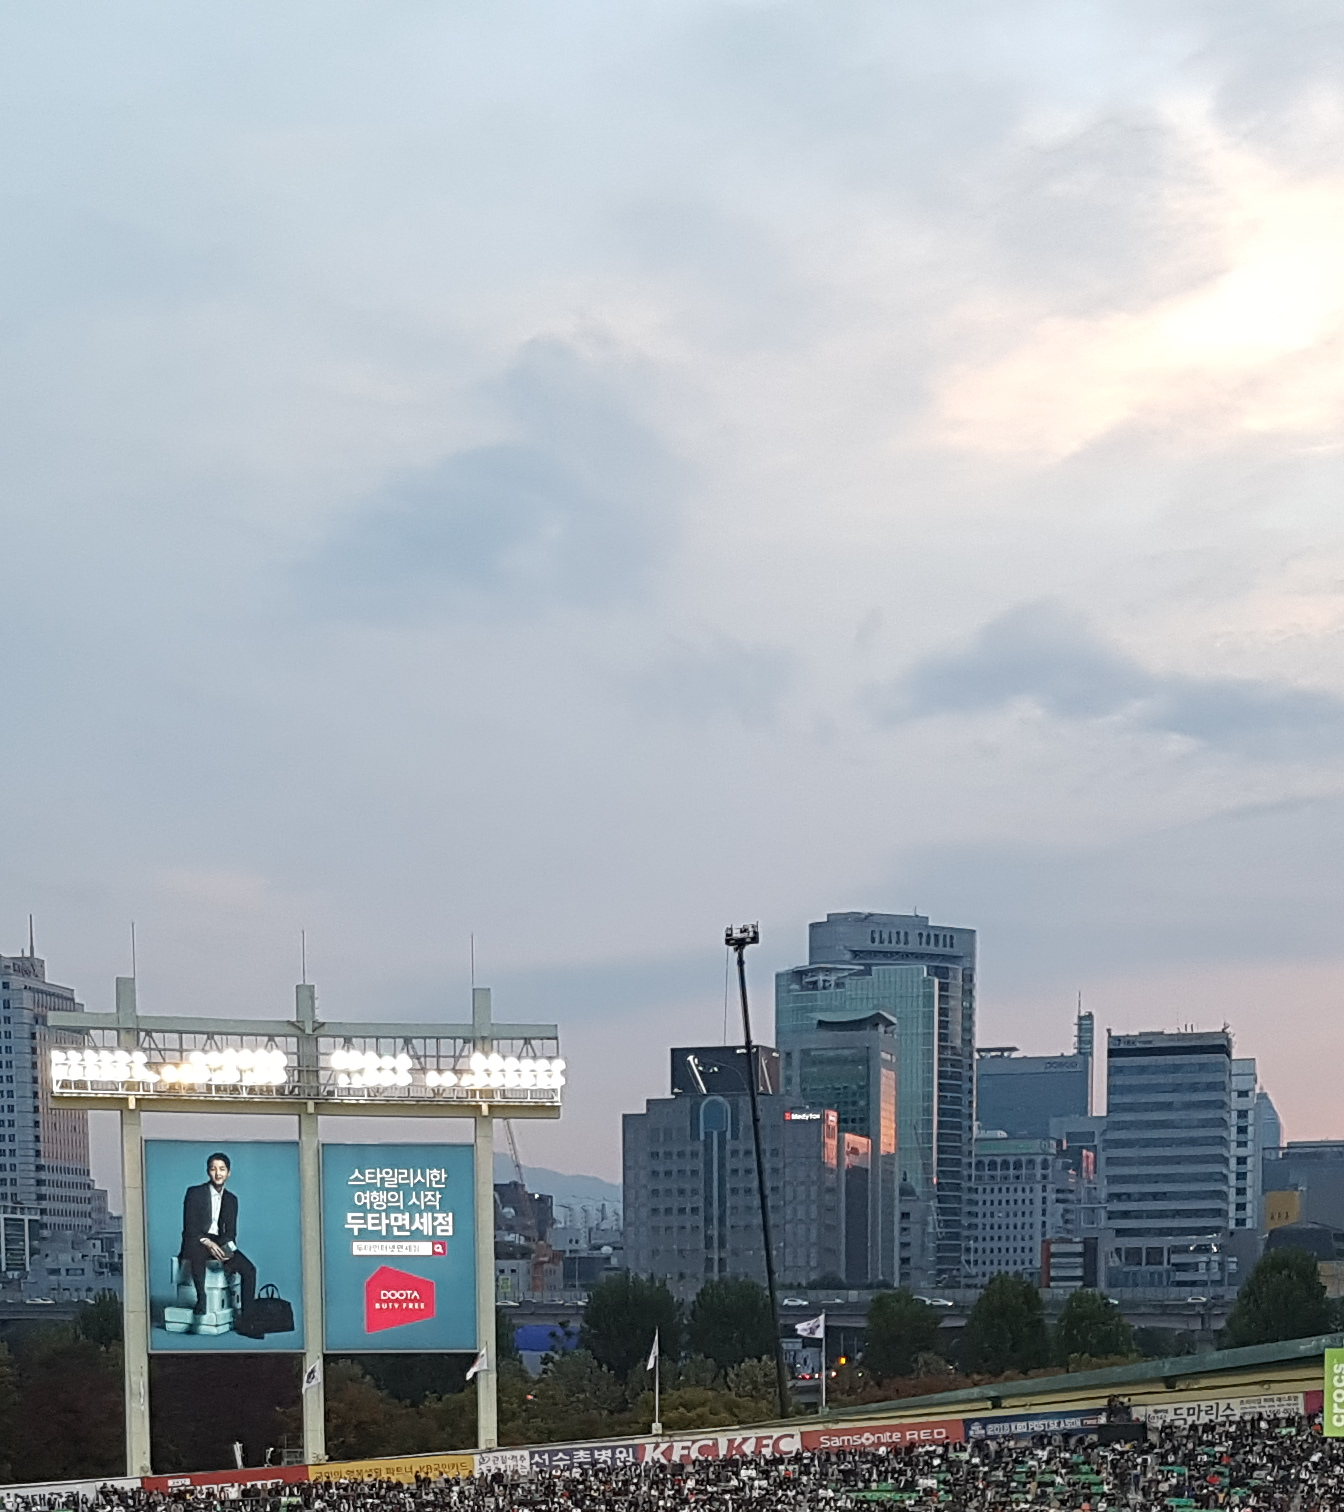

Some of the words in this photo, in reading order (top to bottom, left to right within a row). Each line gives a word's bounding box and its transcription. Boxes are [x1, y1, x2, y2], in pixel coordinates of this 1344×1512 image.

[347, 1168, 447, 1188] 스타일리시한
[354, 1190, 404, 1210] 여행의
[408, 1190, 442, 1210] 시작
[345, 1211, 453, 1236] 두타면세점
[380, 1290, 420, 1300] DOOTA
[726, 1433, 798, 1459] KFC
[820, 1431, 901, 1449] Samsonite
[906, 1427, 946, 1442] RED
[641, 1437, 718, 1465] KFC
